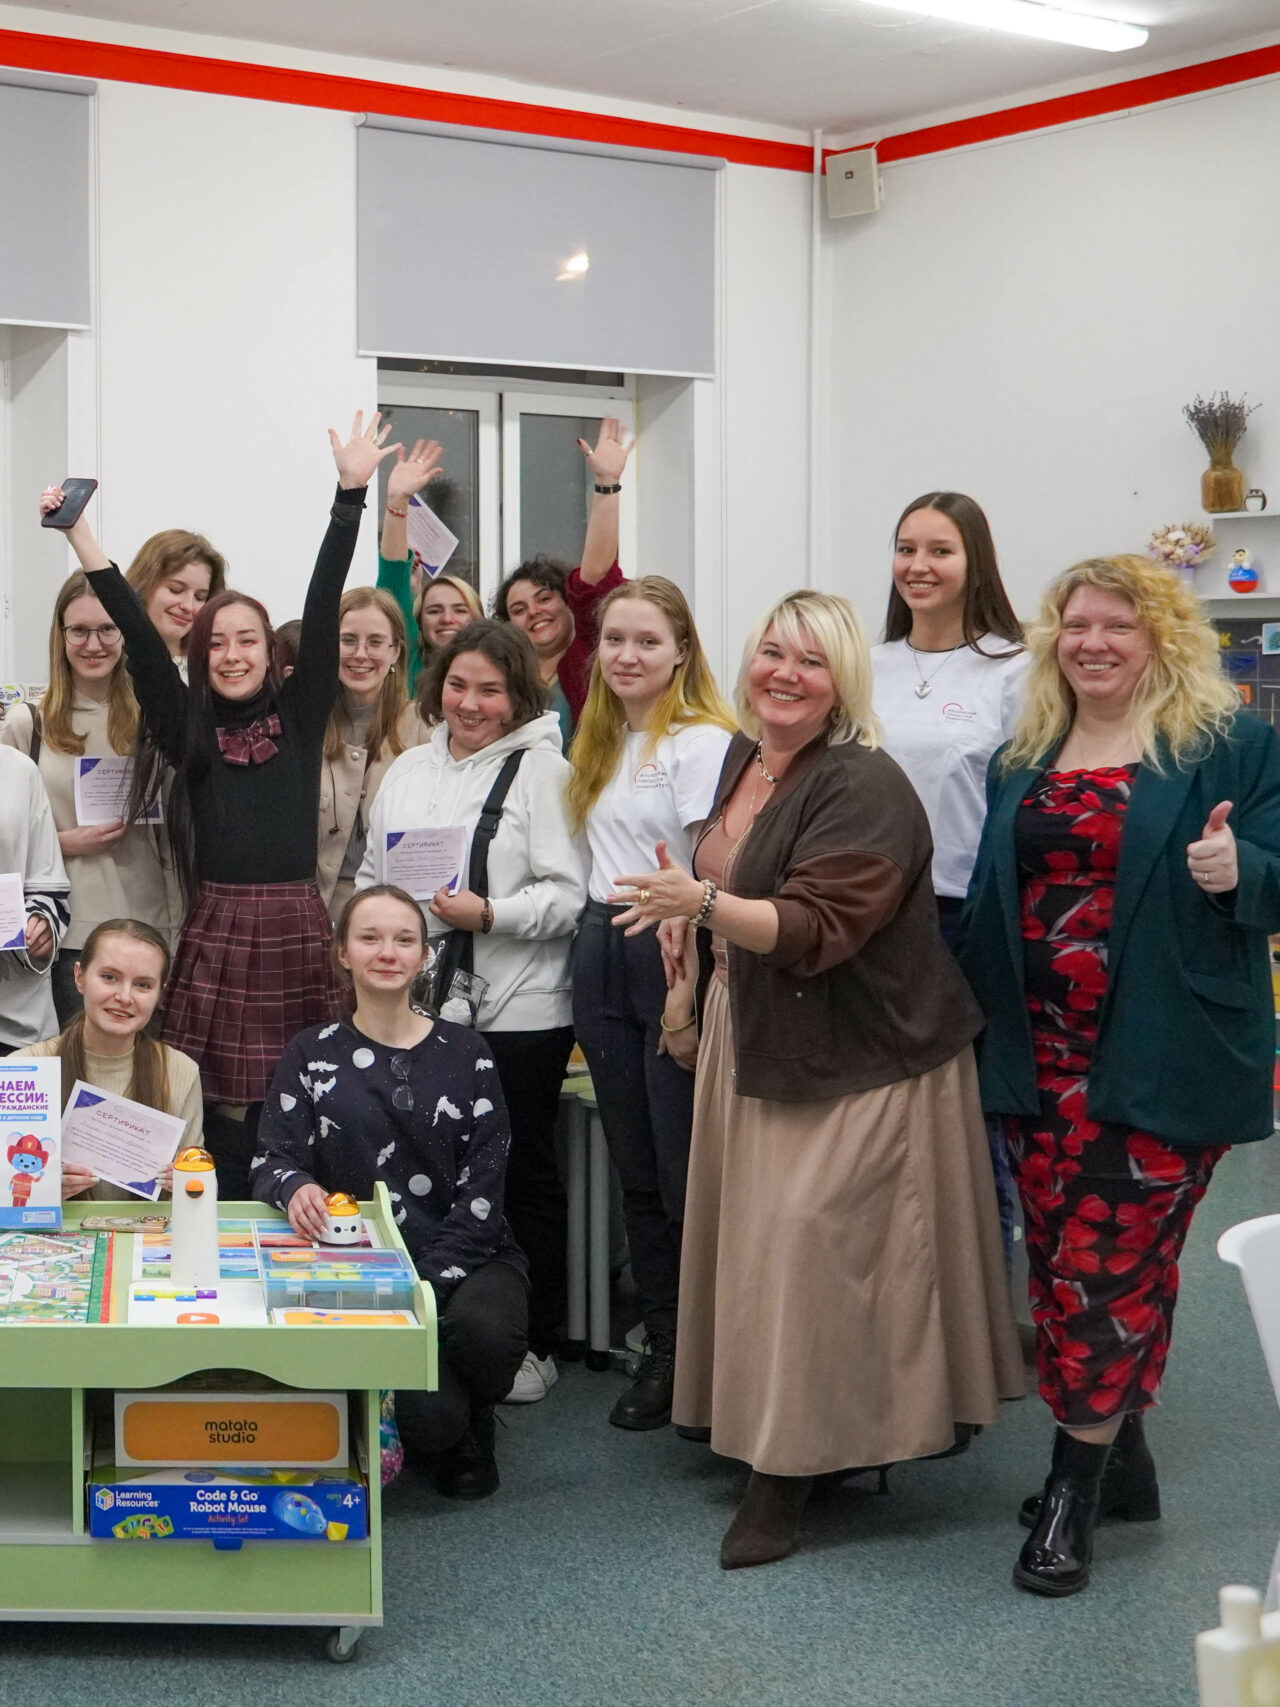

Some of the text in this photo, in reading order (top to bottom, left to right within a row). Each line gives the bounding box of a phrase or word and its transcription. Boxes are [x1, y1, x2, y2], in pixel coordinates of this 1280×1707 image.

[402, 841, 445, 849] СЕРТИФИКАТ
[96, 1110, 151, 1136] СЕРТИФИКАТ
[205, 1419, 258, 1431] matata
[209, 1431, 256, 1443] studio
[116, 1490, 152, 1500] Learning
[196, 1490, 258, 1501] Code & Go
[343, 1493, 361, 1508] 4+
[116, 1499, 159, 1507] Resources
[189, 1501, 267, 1513] Robot Mouse
[208, 1514, 249, 1526] Activity Set
